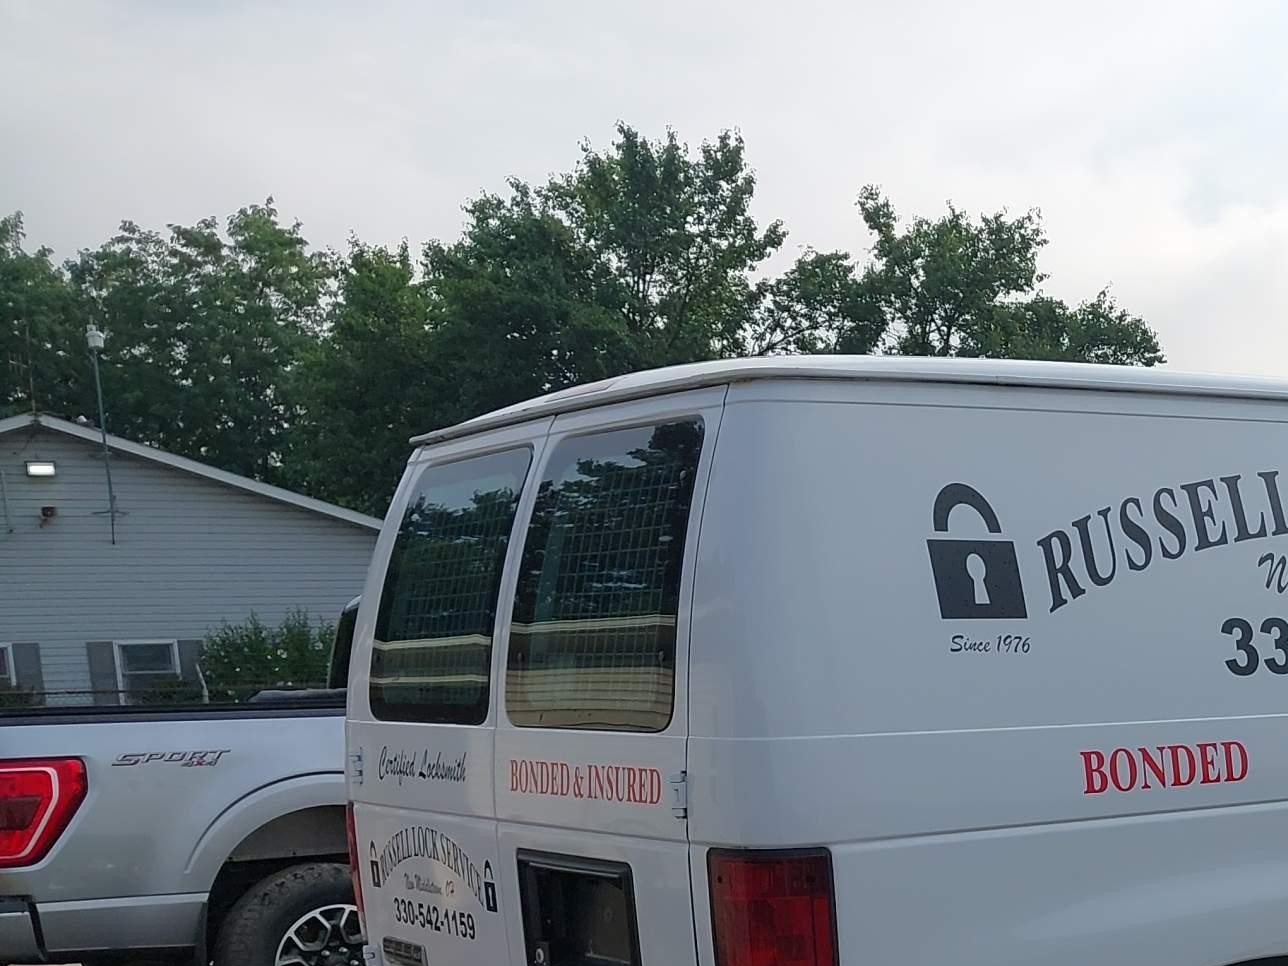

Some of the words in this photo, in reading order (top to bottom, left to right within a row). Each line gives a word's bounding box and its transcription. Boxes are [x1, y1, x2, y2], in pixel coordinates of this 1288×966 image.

[949, 634, 993, 655] Since
[995, 636, 1032, 655] 1976
[112, 749, 231, 767] SPORT
[379, 746, 416, 786] Certified
[418, 749, 467, 782] Locksmith
[1079, 740, 1250, 795] BONDED
[510, 759, 572, 797] BONDED
[573, 767, 586, 798] &
[587, 765, 663, 804] INSURED
[412, 826, 440, 862] LOCK
[440, 833, 484, 906] SERVICE
[393, 897, 476, 940] 330-542-1159
